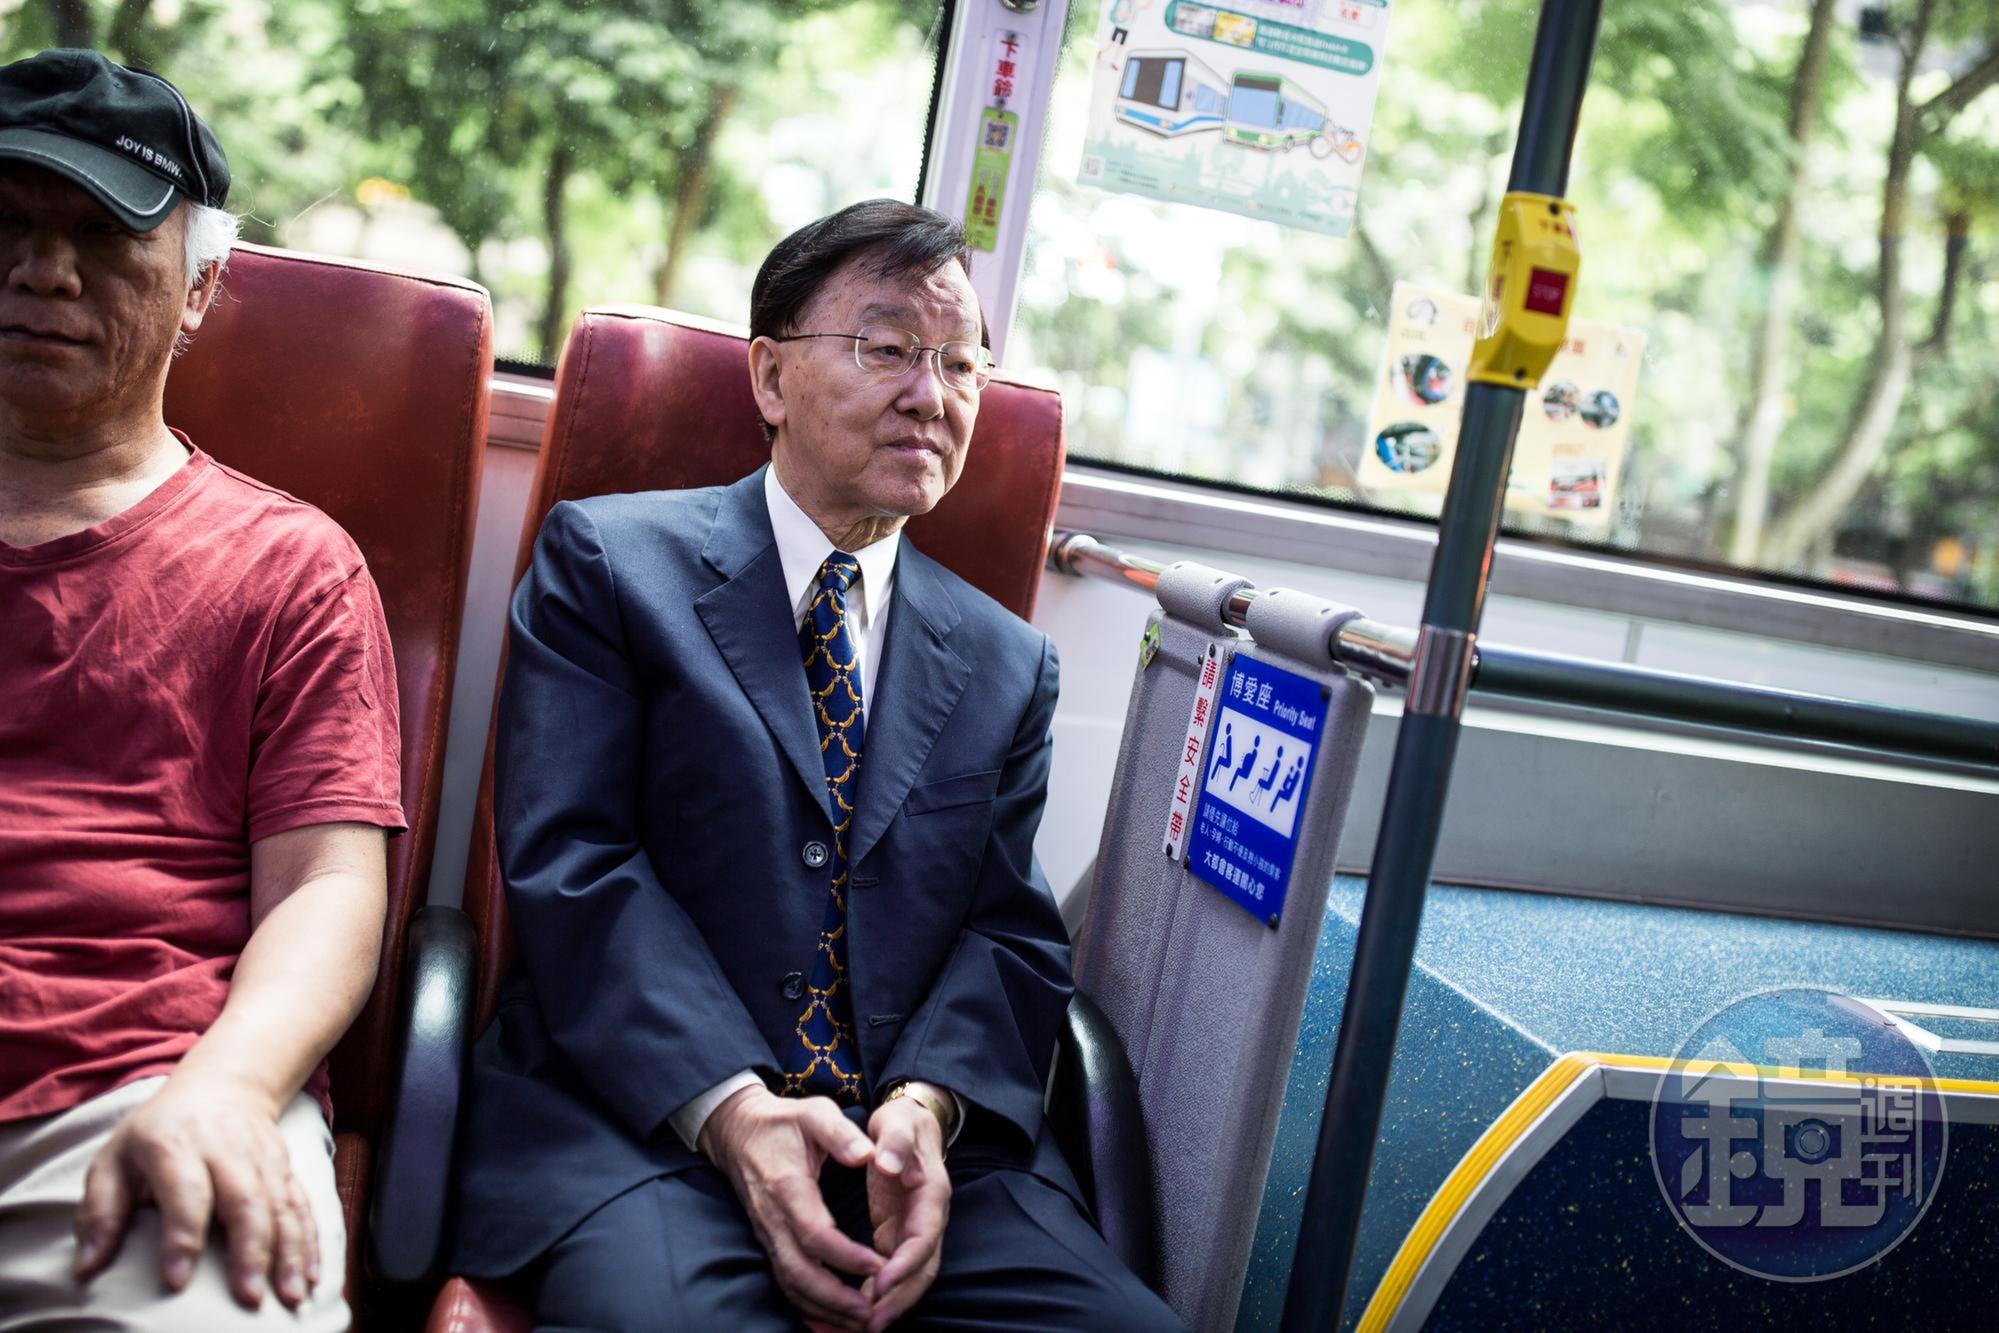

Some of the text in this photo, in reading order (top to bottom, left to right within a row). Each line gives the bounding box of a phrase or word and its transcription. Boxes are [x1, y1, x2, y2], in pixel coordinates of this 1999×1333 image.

[992, 39, 1020, 98] 下車鈴
[116, 134, 183, 178] JOY IS BMW.
[1229, 669, 1274, 712] 博愛座
[1273, 699, 1317, 731] Priority Seat
[1203, 849, 1266, 901] 大都會客運關心您
